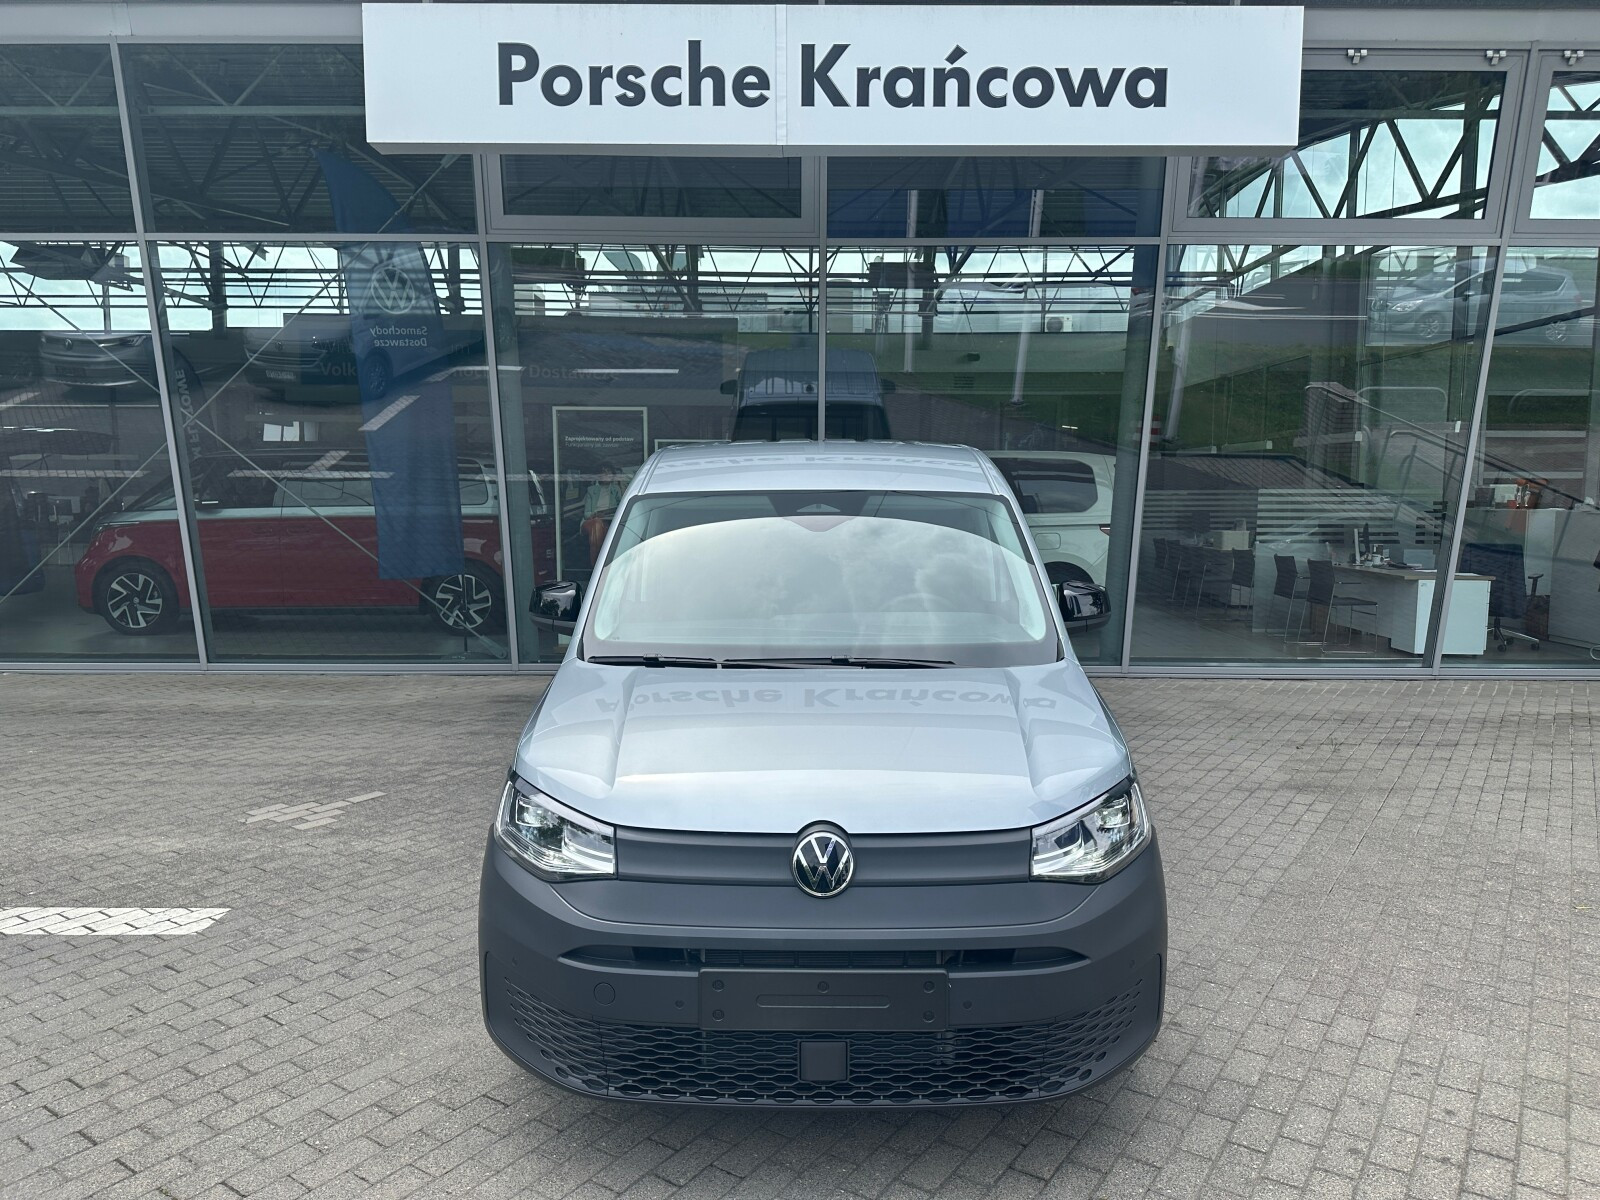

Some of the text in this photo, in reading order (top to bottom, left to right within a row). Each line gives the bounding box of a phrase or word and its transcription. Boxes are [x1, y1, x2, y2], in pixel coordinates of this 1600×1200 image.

[498, 40, 1168, 108] Porsche Krańcowa
[792, 831, 854, 897] VW
